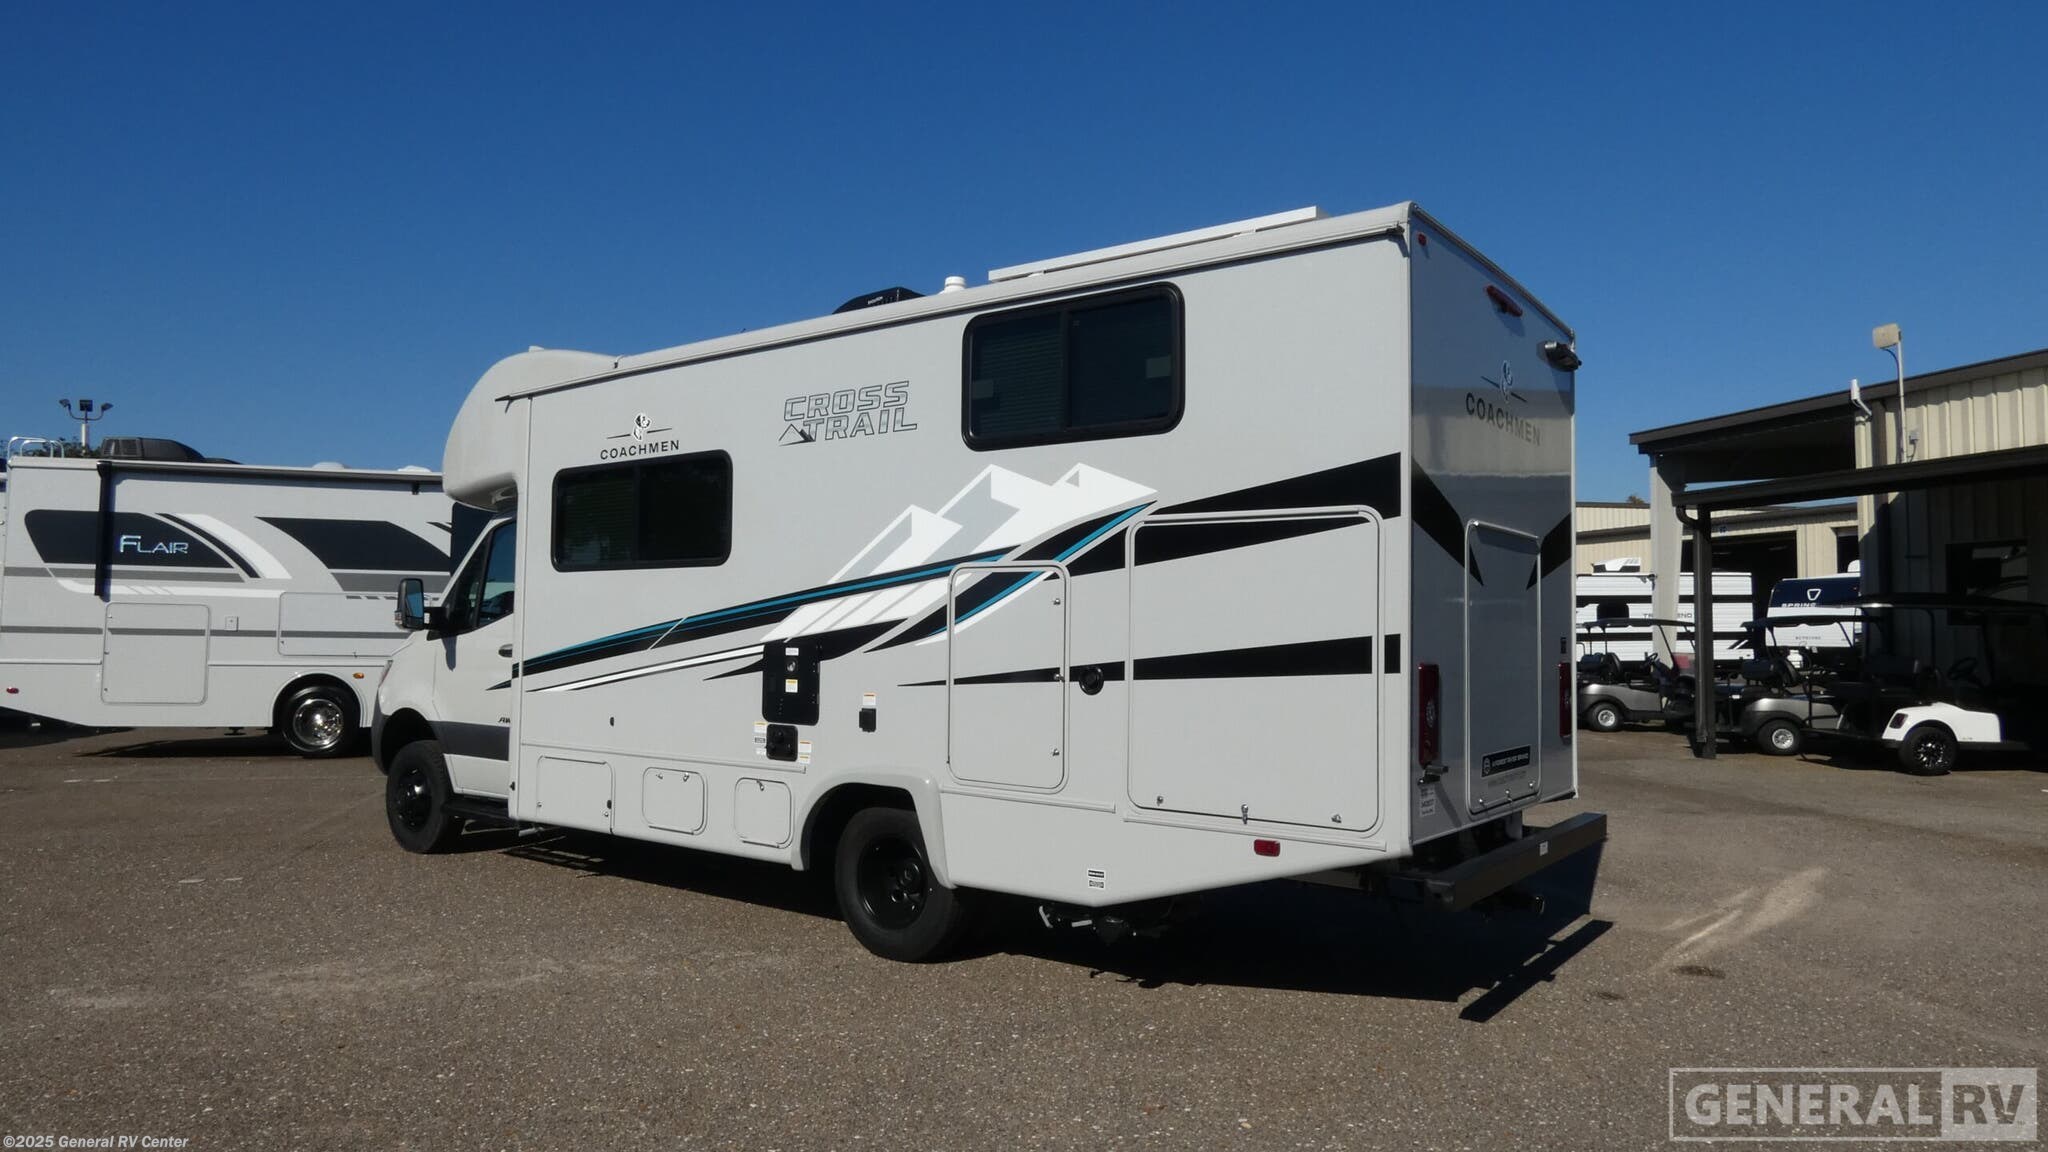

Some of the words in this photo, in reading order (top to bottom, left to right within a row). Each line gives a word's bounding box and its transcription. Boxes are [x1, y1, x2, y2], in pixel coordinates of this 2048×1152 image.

[784, 380, 909, 421] CROSS
[803, 407, 918, 442] TRAIL
[1465, 392, 1541, 446] COACHMEN
[600, 440, 680, 460] COACHMEN
[120, 535, 189, 554] FLAIR
